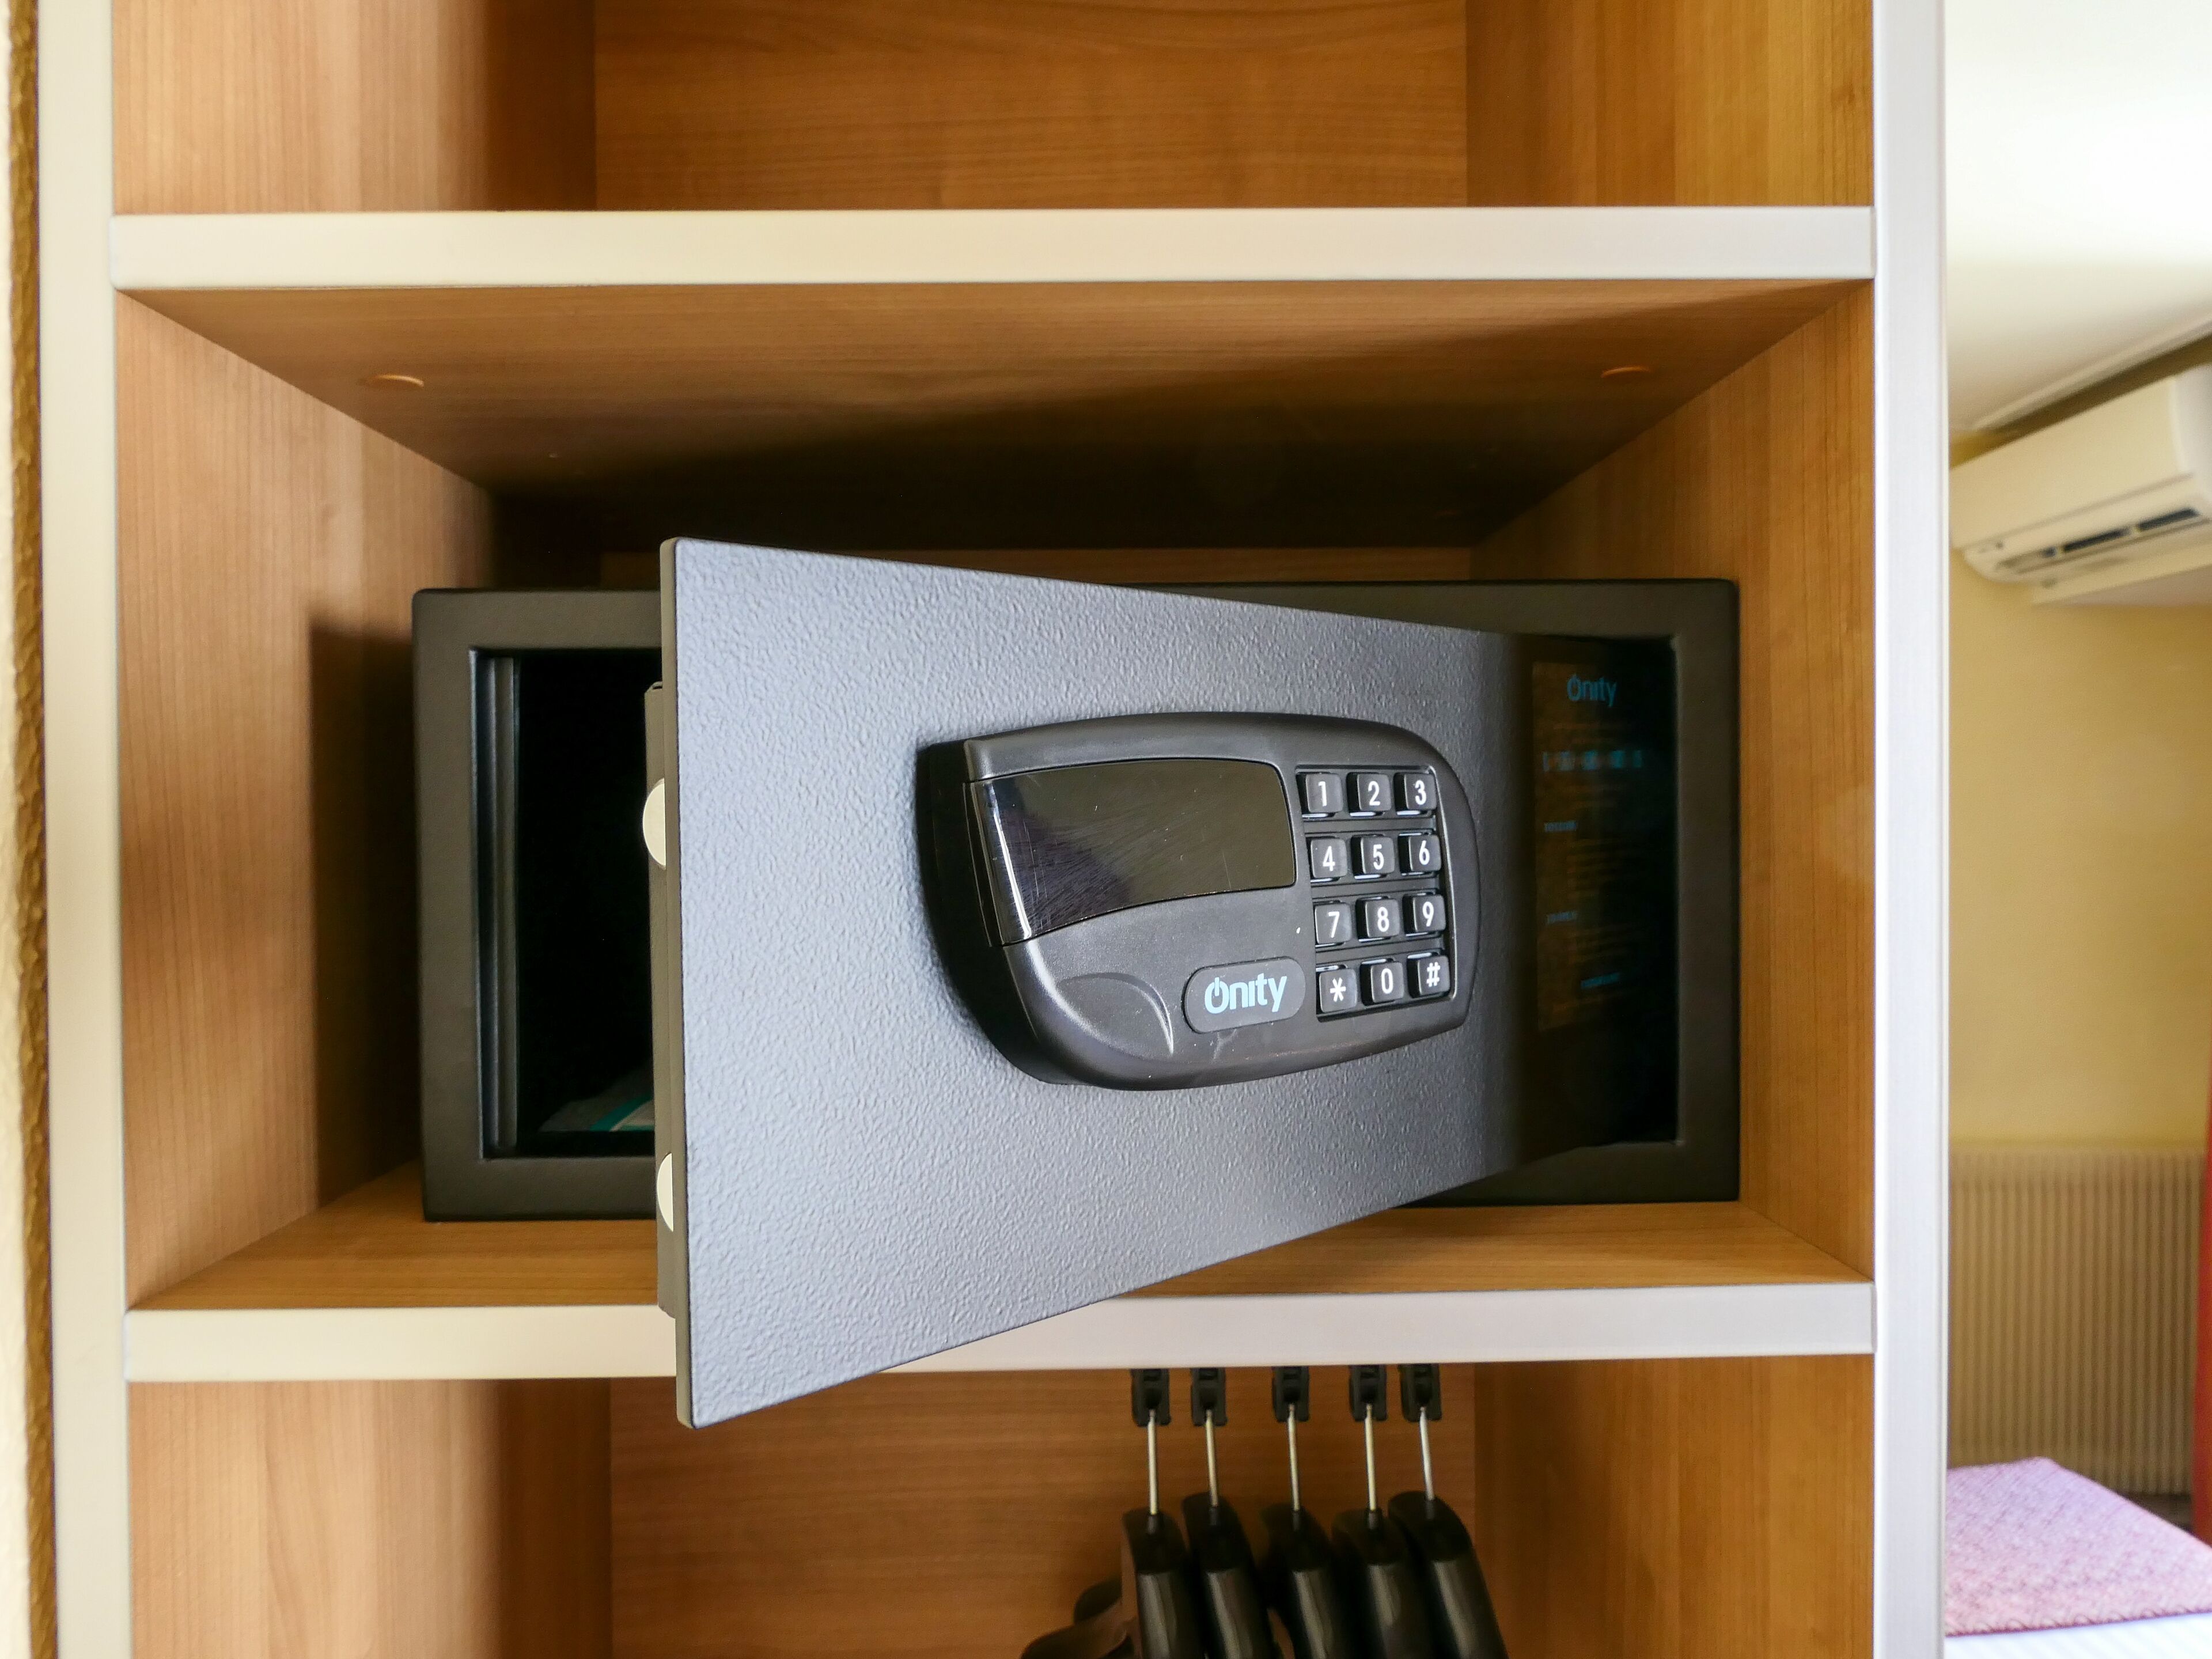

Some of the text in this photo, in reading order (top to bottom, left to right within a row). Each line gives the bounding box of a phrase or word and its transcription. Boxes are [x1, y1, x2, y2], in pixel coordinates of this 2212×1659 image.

[1319, 781, 1426, 806] 1 2 3
[1323, 840, 1429, 871] 4 5 6
[1328, 902, 1434, 938] 7 8 9
[1205, 973, 1287, 1014] Onity
[1381, 968, 1393, 994] 0
